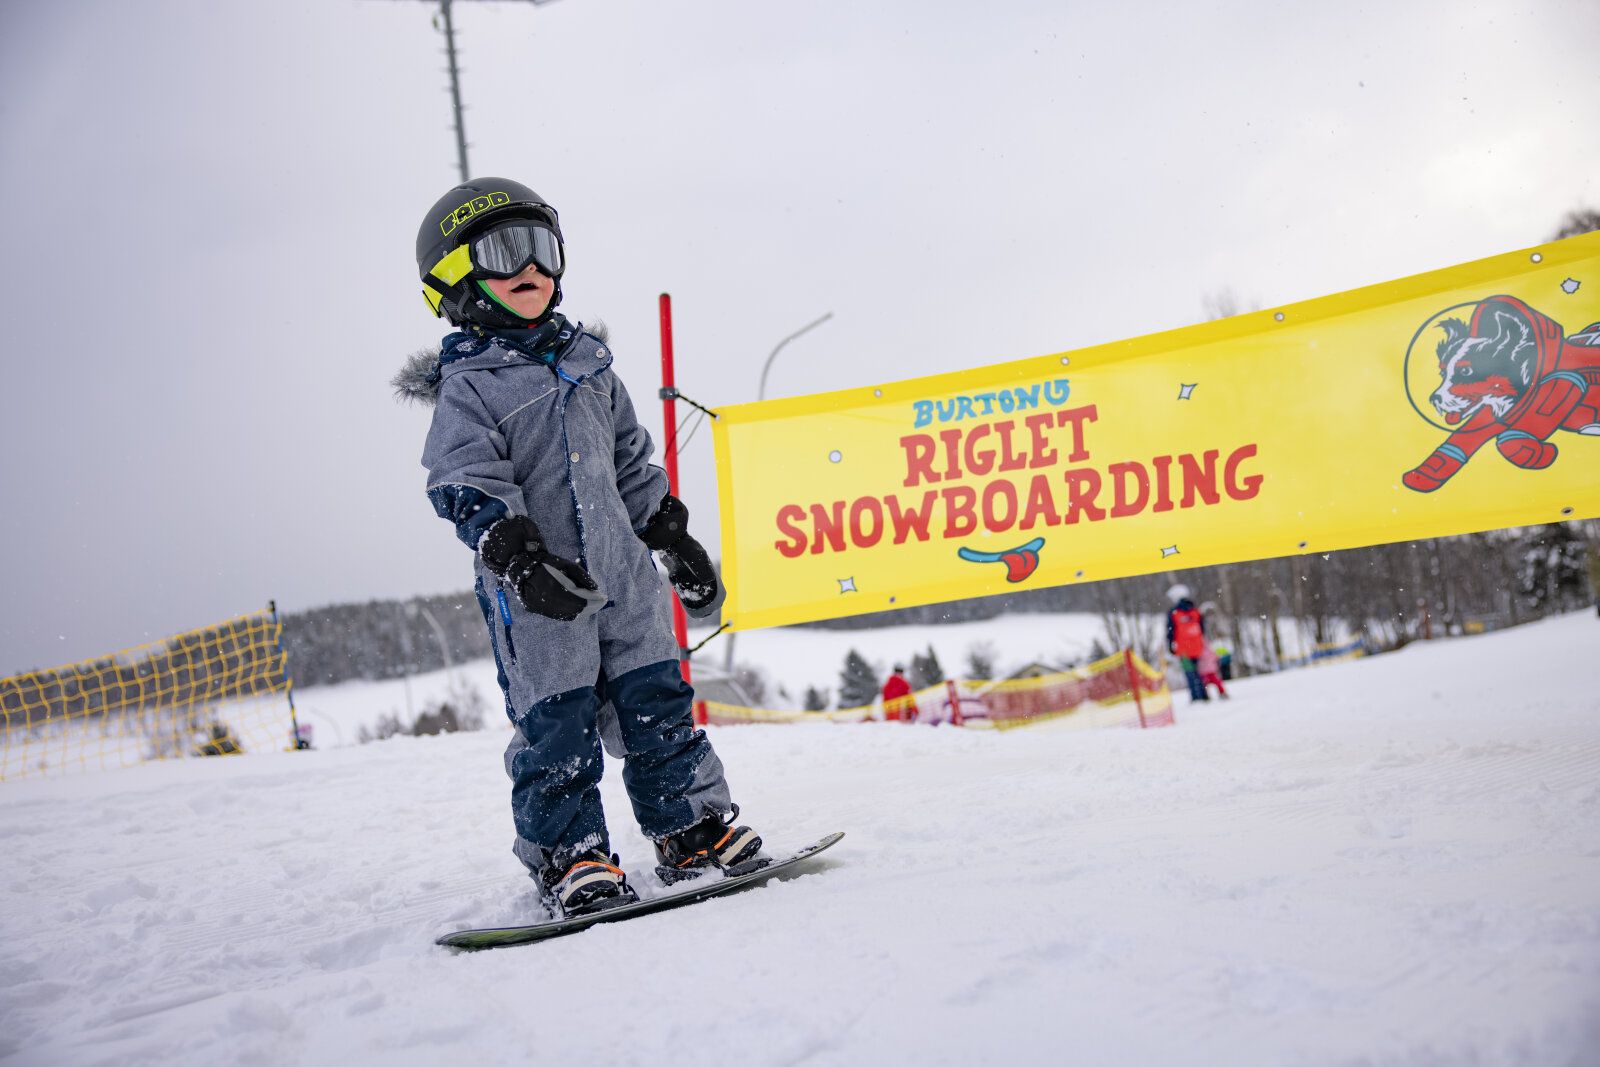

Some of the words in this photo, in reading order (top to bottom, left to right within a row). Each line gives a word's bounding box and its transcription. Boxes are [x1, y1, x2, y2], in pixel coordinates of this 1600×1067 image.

[900, 404, 1098, 487] RIGLET
[913, 384, 1041, 429] BURTON
[775, 443, 1264, 558] SNOWBOARDING
